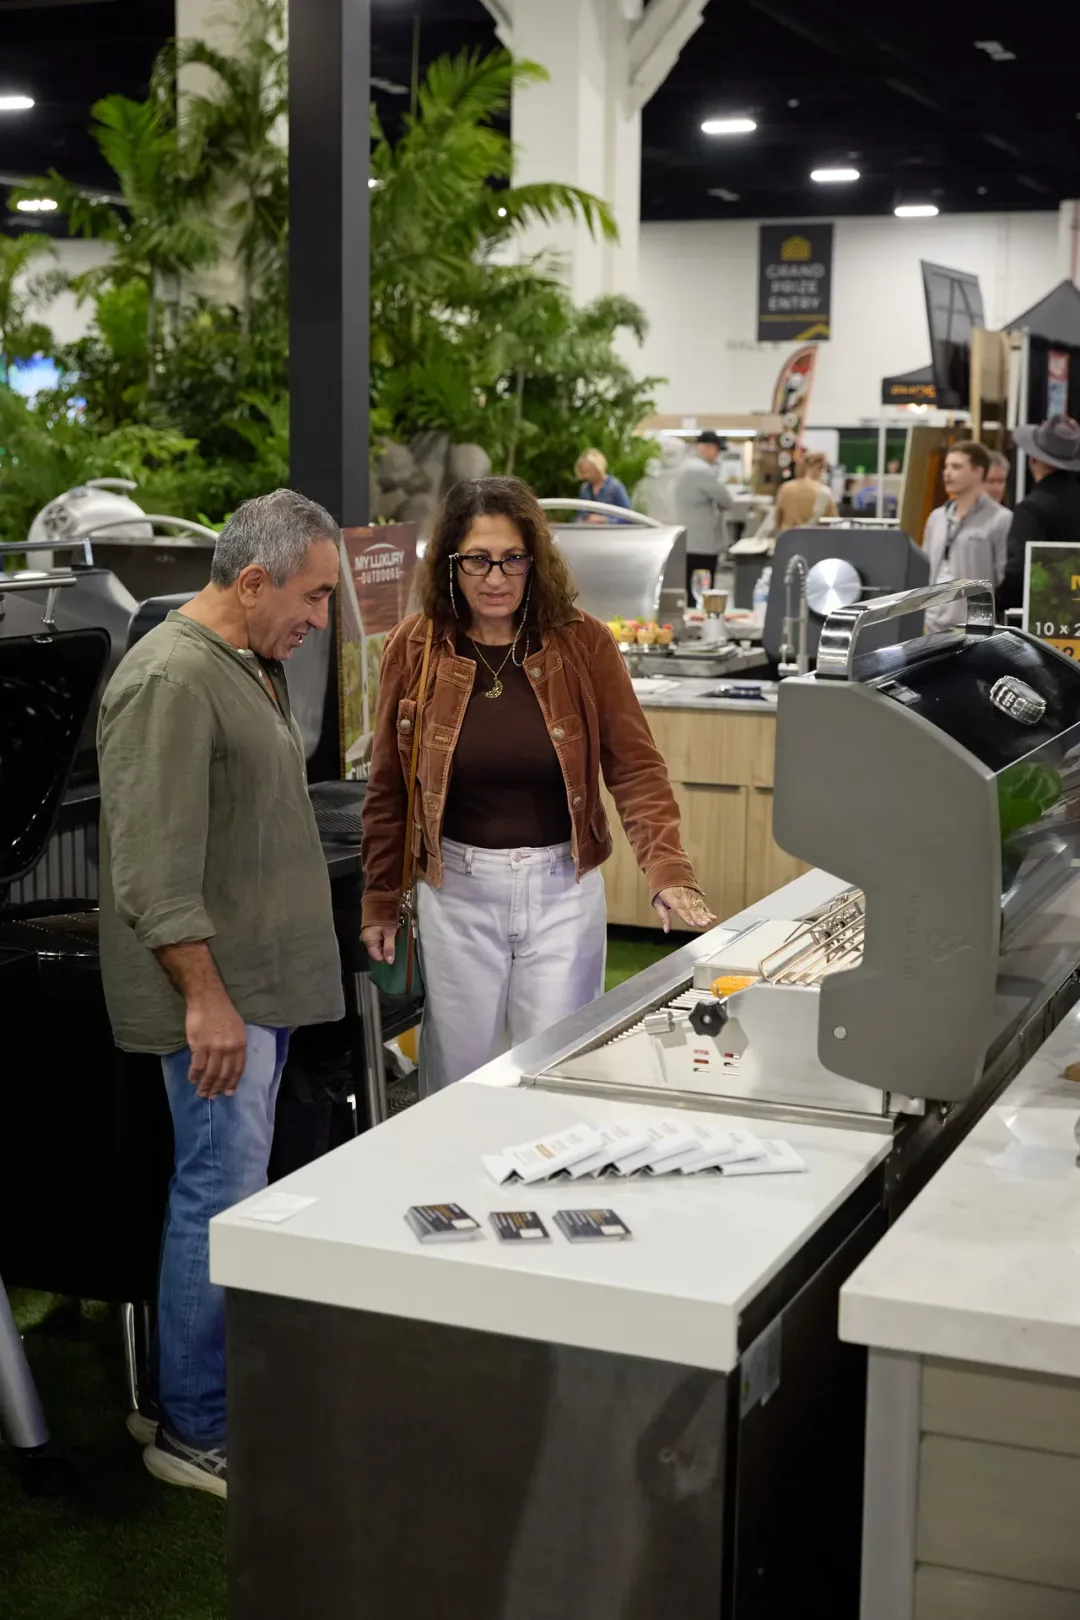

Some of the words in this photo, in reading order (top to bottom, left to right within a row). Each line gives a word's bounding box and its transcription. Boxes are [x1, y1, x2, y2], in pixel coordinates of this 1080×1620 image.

[765, 263, 826, 279] GRAND
[771, 280, 819, 295] PRIZE
[767, 296, 821, 311] ENTRY
[354, 556, 369, 571] MY
[370, 551, 405, 569] LUXURY
[361, 567, 400, 585] OUTDOORS
[1035, 622, 1055, 636] 10
